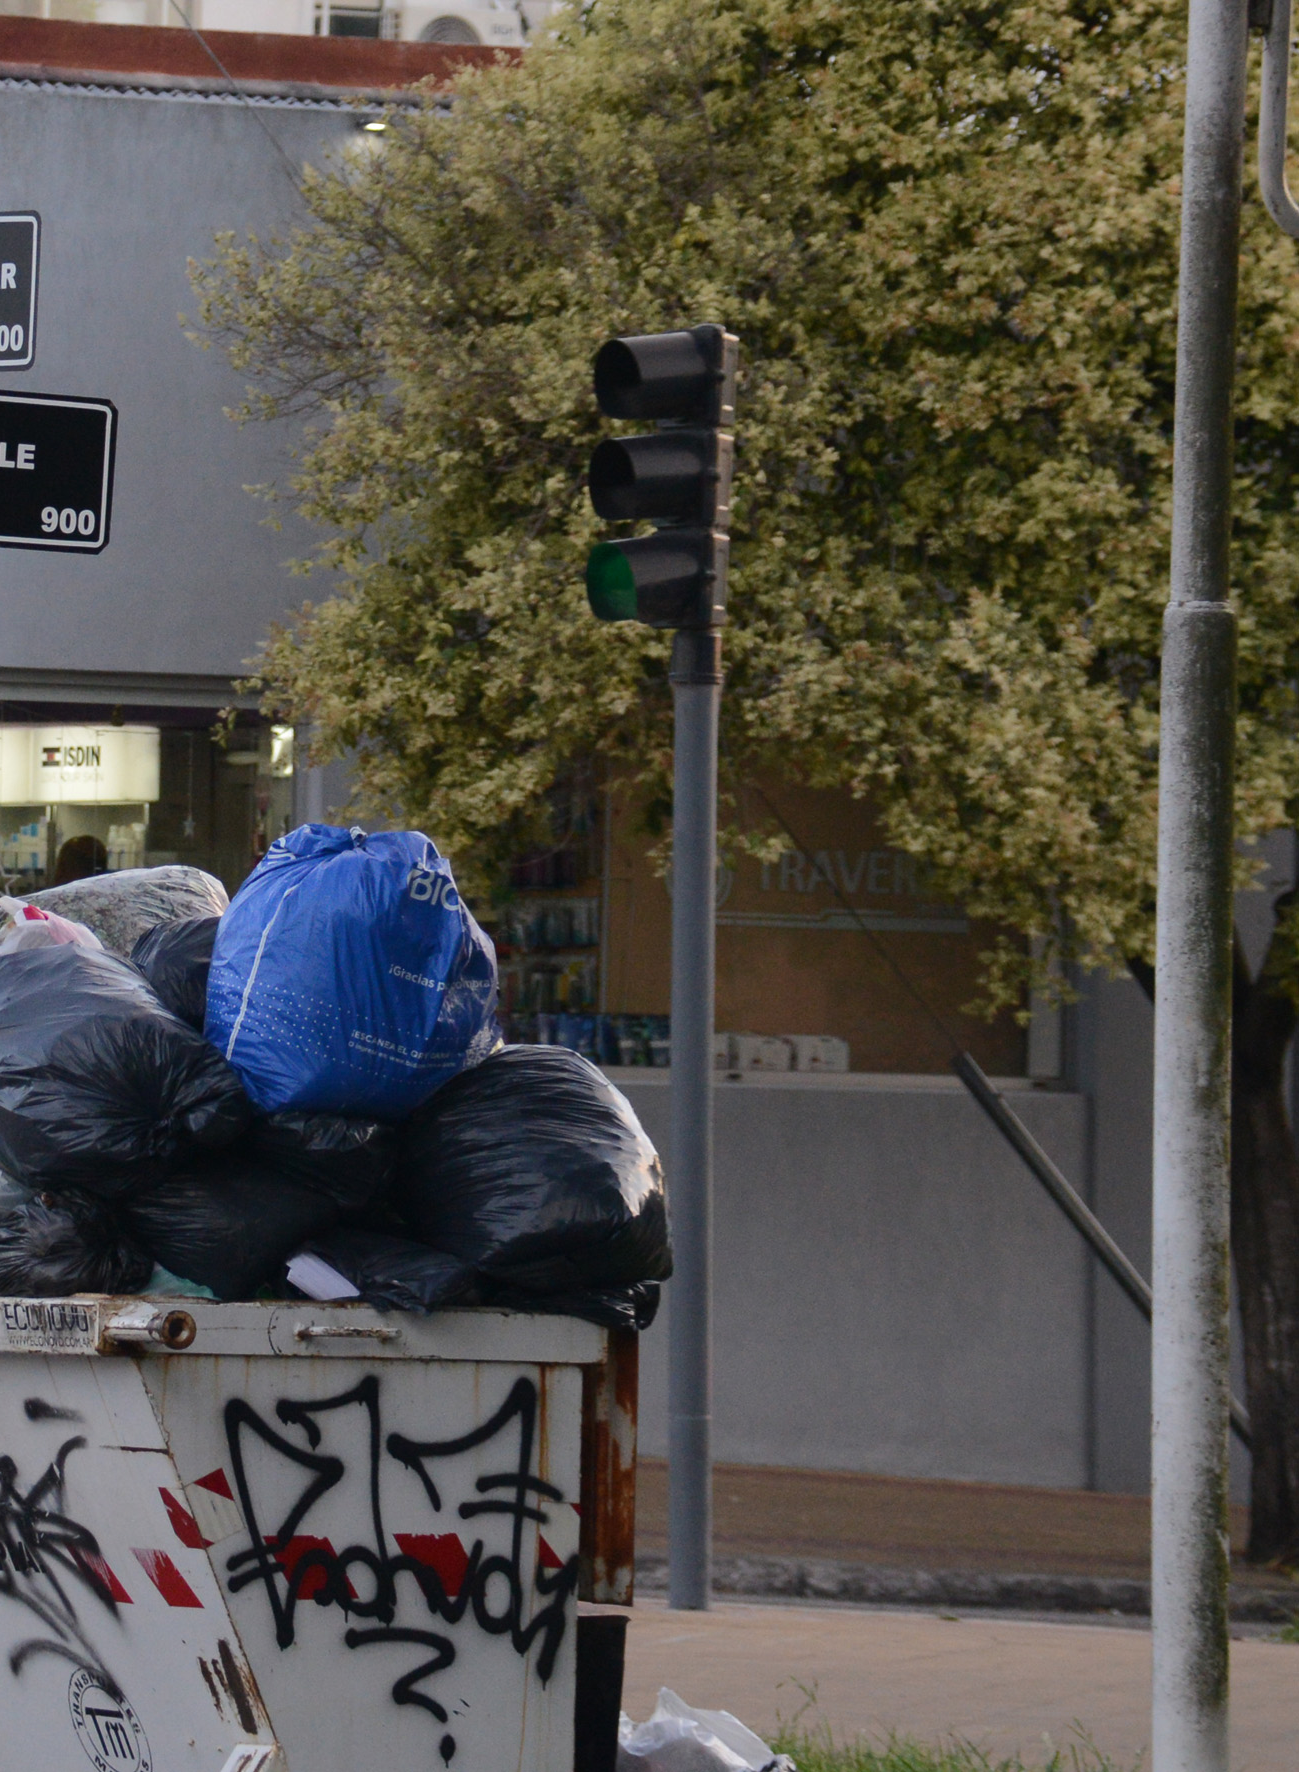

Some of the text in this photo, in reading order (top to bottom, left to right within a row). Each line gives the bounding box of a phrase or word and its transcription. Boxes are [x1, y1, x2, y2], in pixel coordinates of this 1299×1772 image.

[41, 506, 96, 536] 900
[63, 746, 101, 767] ISDIN
[759, 850, 919, 895] TRAVER
